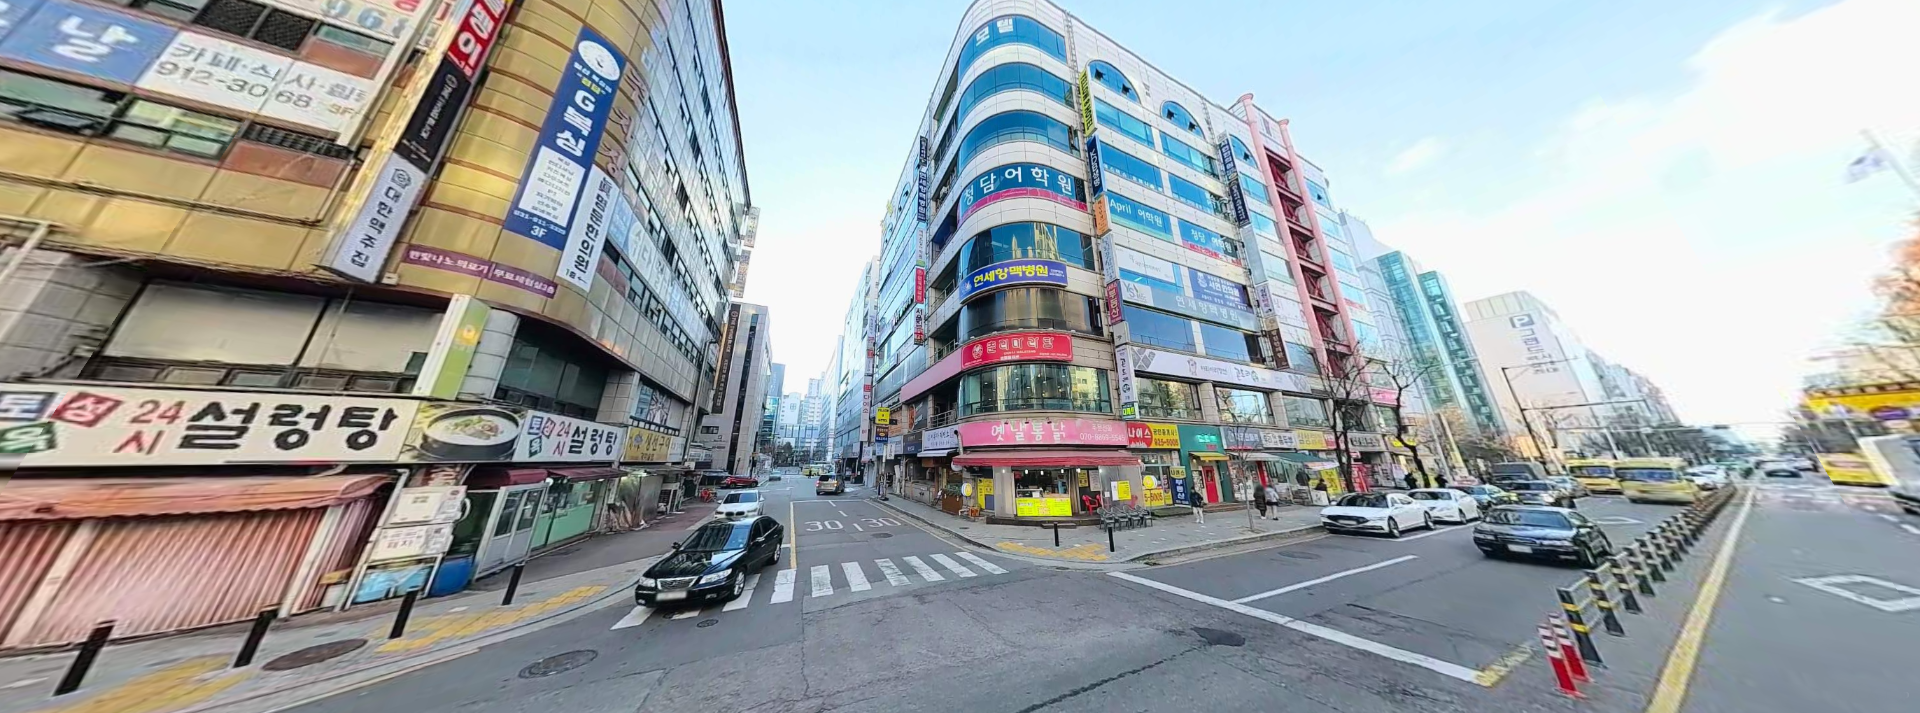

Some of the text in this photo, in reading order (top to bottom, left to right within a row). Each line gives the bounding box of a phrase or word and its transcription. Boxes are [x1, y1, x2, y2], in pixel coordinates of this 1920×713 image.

[975, 17, 1013, 46] 모텔
[1085, 104, 1094, 131] HOTEL
[964, 166, 1073, 205] 청담어학원
[1110, 198, 1132, 215] April
[1138, 209, 1163, 227] 어학원
[349, 186, 402, 268] 대한맥주집
[530, 225, 547, 238] 3F
[1191, 228, 1206, 243] 청담
[129, 400, 184, 425] 24
[177, 401, 399, 450] 설렁탕
[991, 421, 1066, 442] 옛날통닭
[1128, 427, 1151, 439] 나이스
[113, 429, 165, 455] 시
[552, 441, 566, 456] 시
[557, 421, 572, 438] 24
[568, 426, 618, 456] 설렁탕
[805, 520, 843, 532] 30
[861, 517, 902, 528] 30
